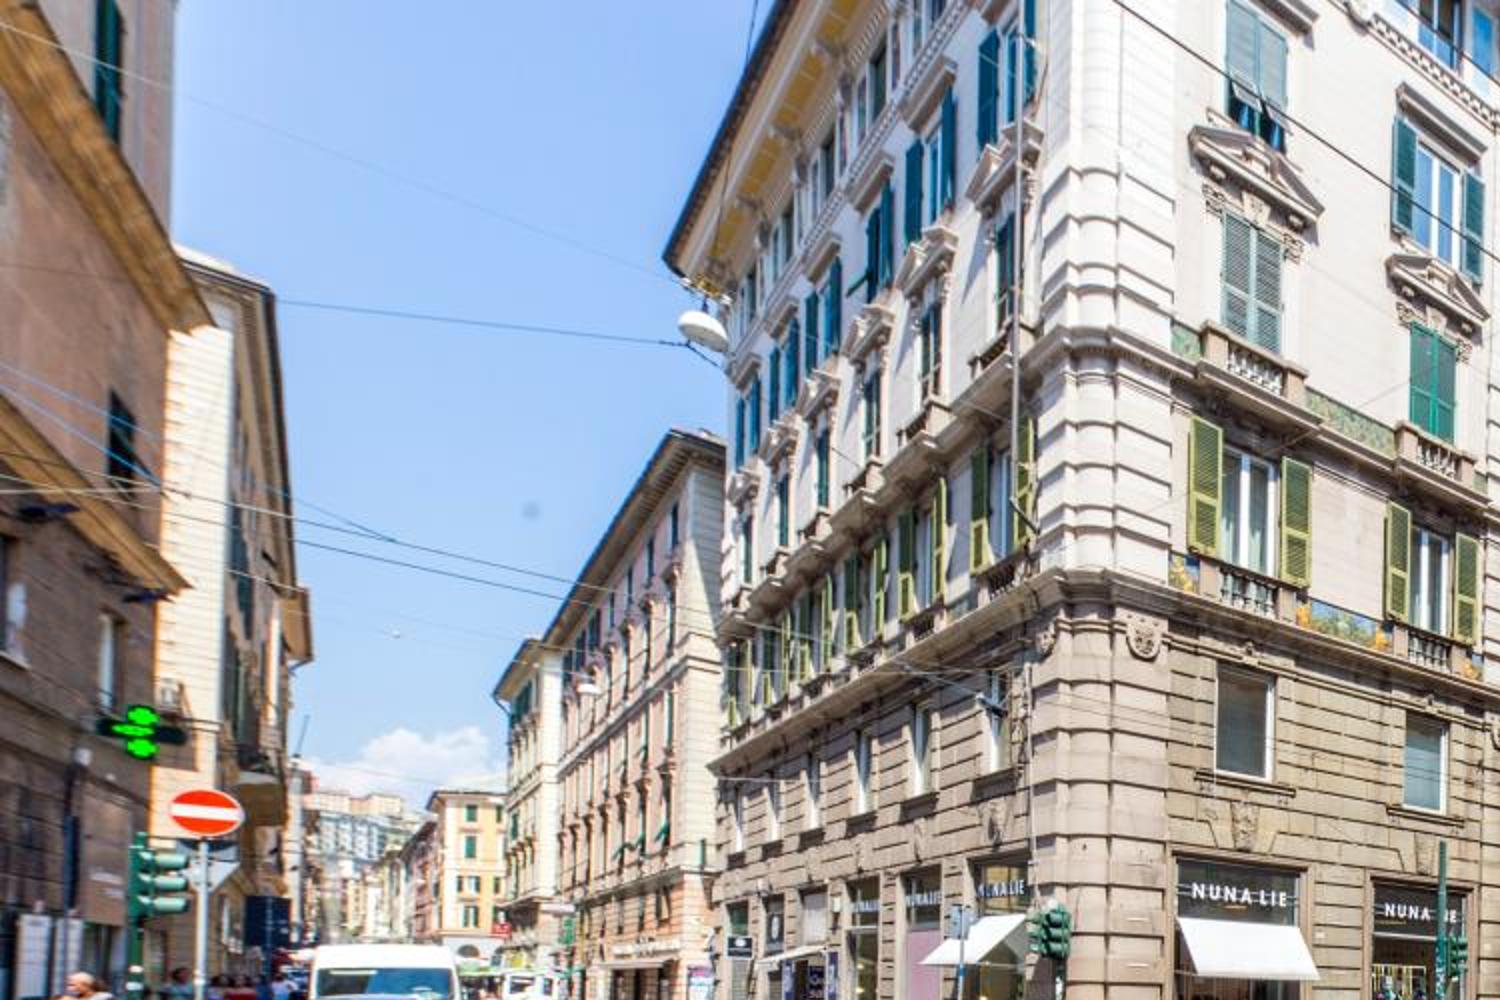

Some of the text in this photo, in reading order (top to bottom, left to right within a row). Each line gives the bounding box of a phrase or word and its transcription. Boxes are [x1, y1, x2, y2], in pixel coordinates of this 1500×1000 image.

[1191, 882, 1287, 907] NUNA LIE
[1384, 902, 1431, 921] NUNA
